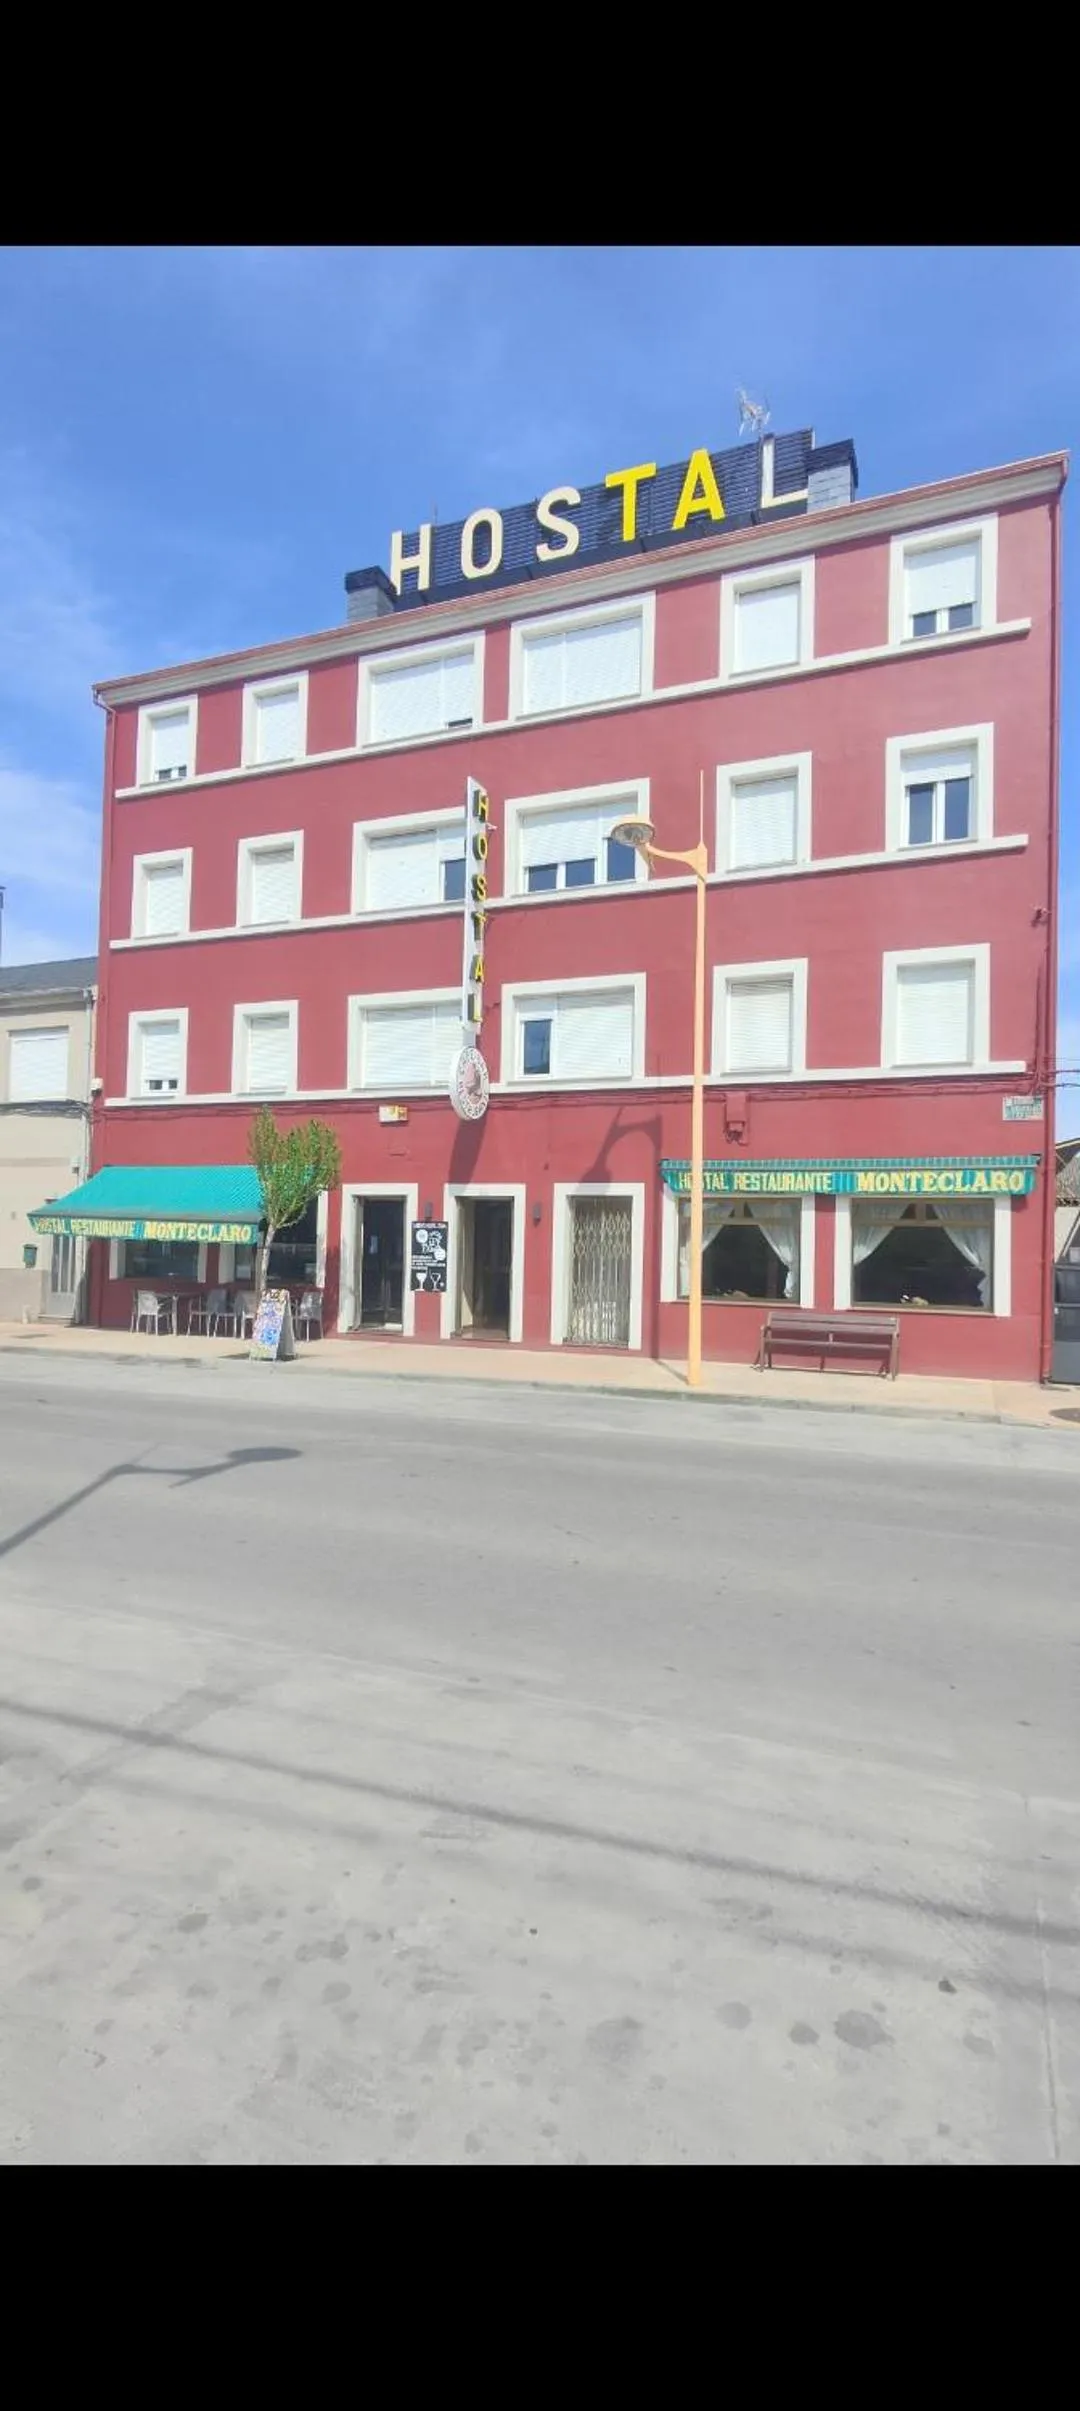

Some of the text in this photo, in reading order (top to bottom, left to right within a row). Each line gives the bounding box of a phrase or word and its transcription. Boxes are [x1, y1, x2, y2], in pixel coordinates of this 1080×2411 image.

[389, 437, 809, 596] HOSTAL
[471, 790, 489, 1023] HOSTAL
[679, 1169, 1025, 1193] HOTAL RESTAURANTE MONTECLARO
[71, 1219, 134, 1237] RESTAURANTE
[144, 1220, 252, 1241] MONTECLARO
